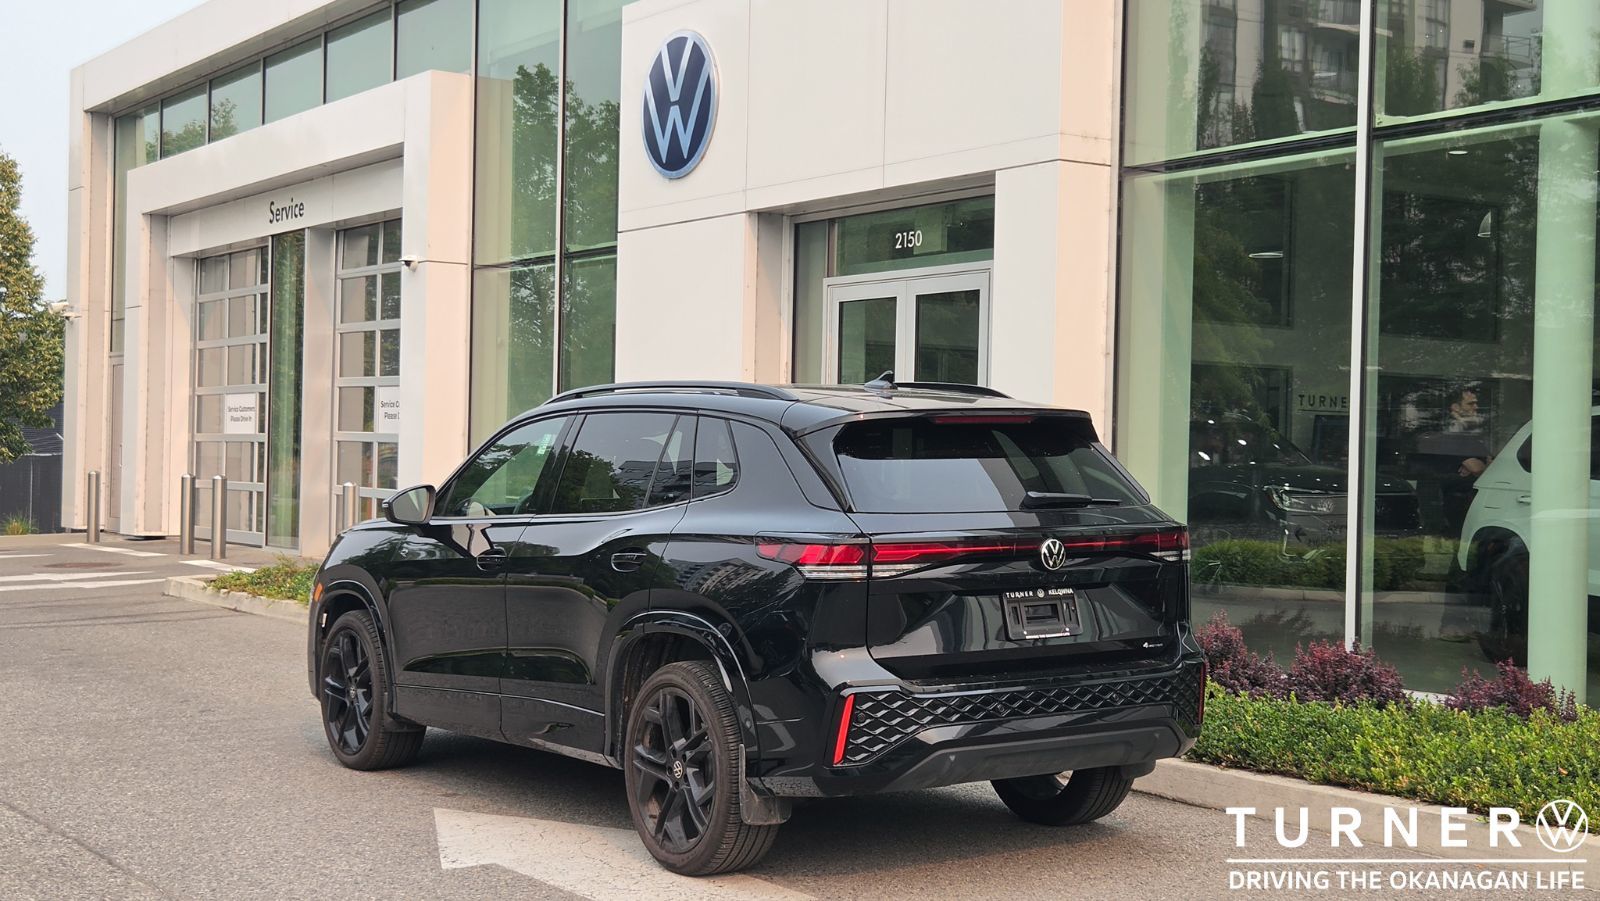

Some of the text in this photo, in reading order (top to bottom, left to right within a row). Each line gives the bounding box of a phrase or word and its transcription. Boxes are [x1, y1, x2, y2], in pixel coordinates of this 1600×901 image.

[269, 197, 305, 224] Service
[895, 230, 923, 249] 2150
[380, 400, 395, 408] Service
[1298, 394, 1348, 408] TURNE
[1048, 588, 1074, 596] KELOWNA
